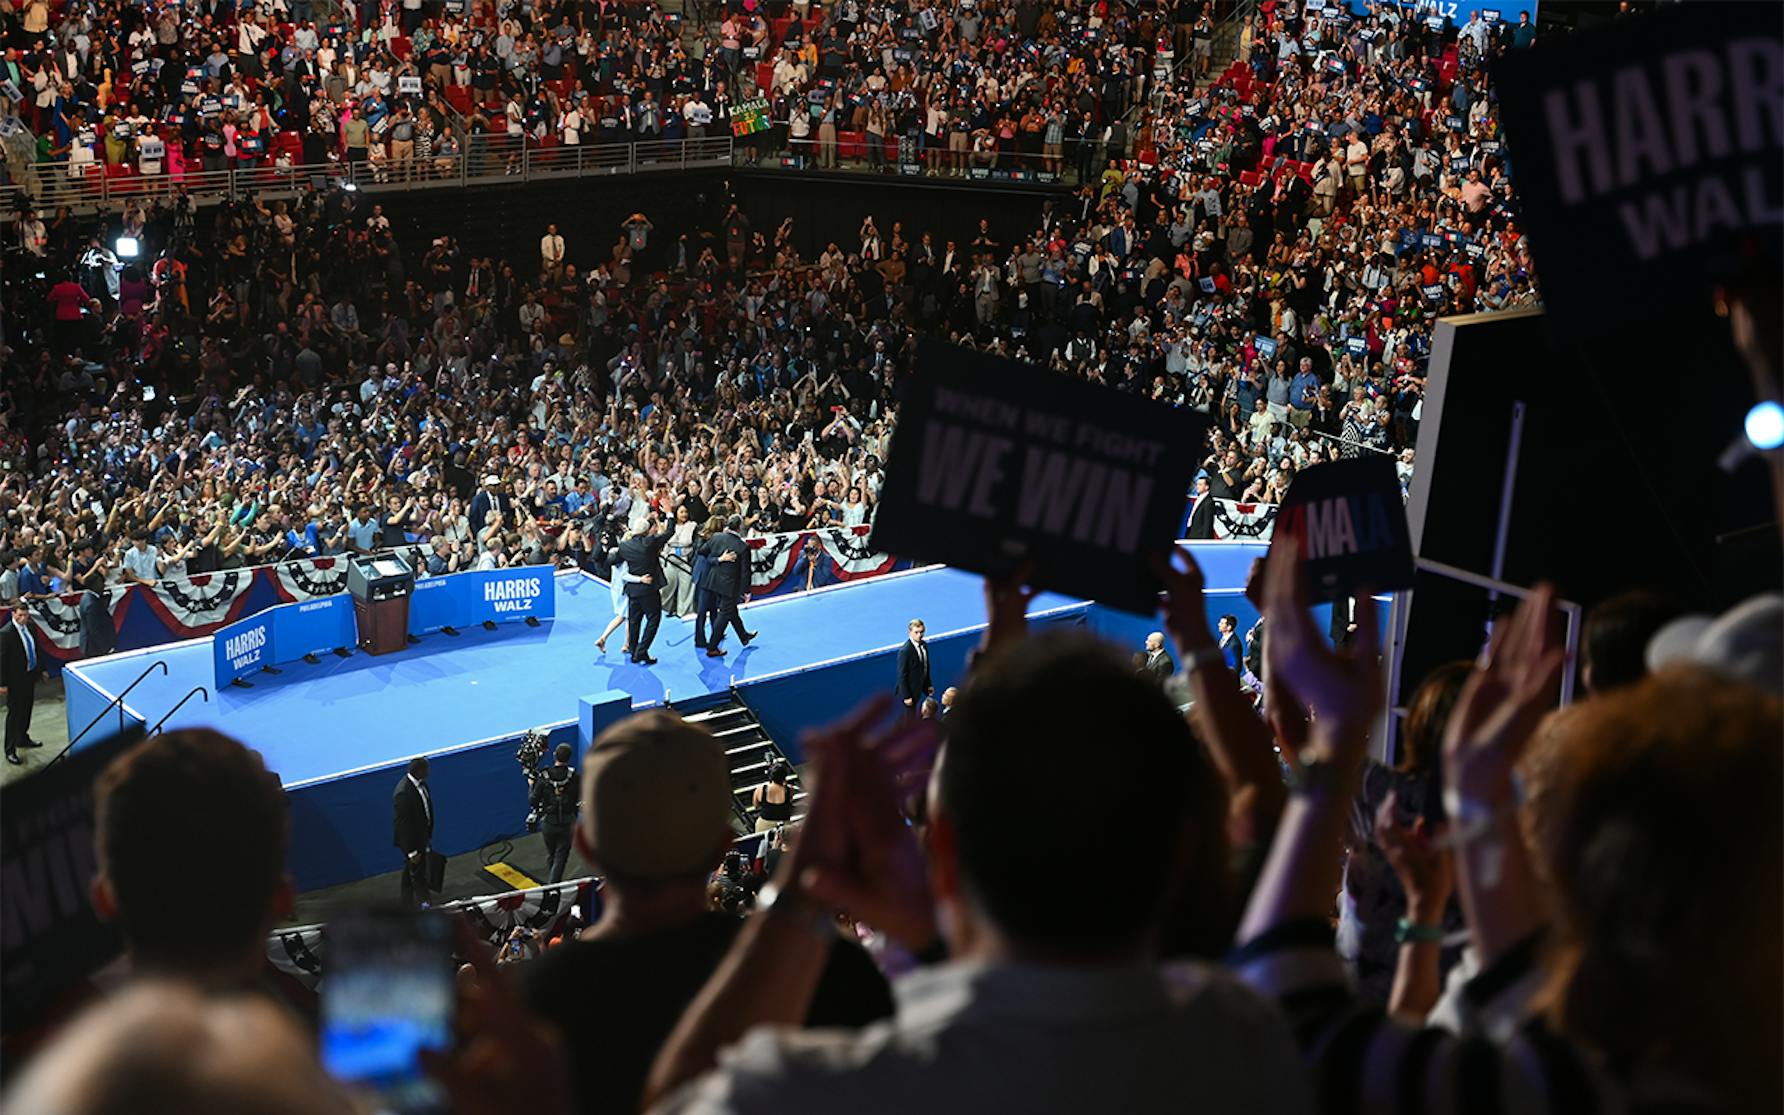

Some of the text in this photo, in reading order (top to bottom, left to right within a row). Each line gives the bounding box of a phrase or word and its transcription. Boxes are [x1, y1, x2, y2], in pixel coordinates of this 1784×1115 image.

[1541, 33, 1784, 208] HARR
[932, 385, 1166, 467] WHEN WE FIGHT
[915, 419, 1158, 556] WE WIN
[484, 577, 541, 602] HARRIS
[493, 598, 533, 613] WALZ
[225, 624, 266, 661] HARRIS
[232, 647, 261, 671] WALZ
